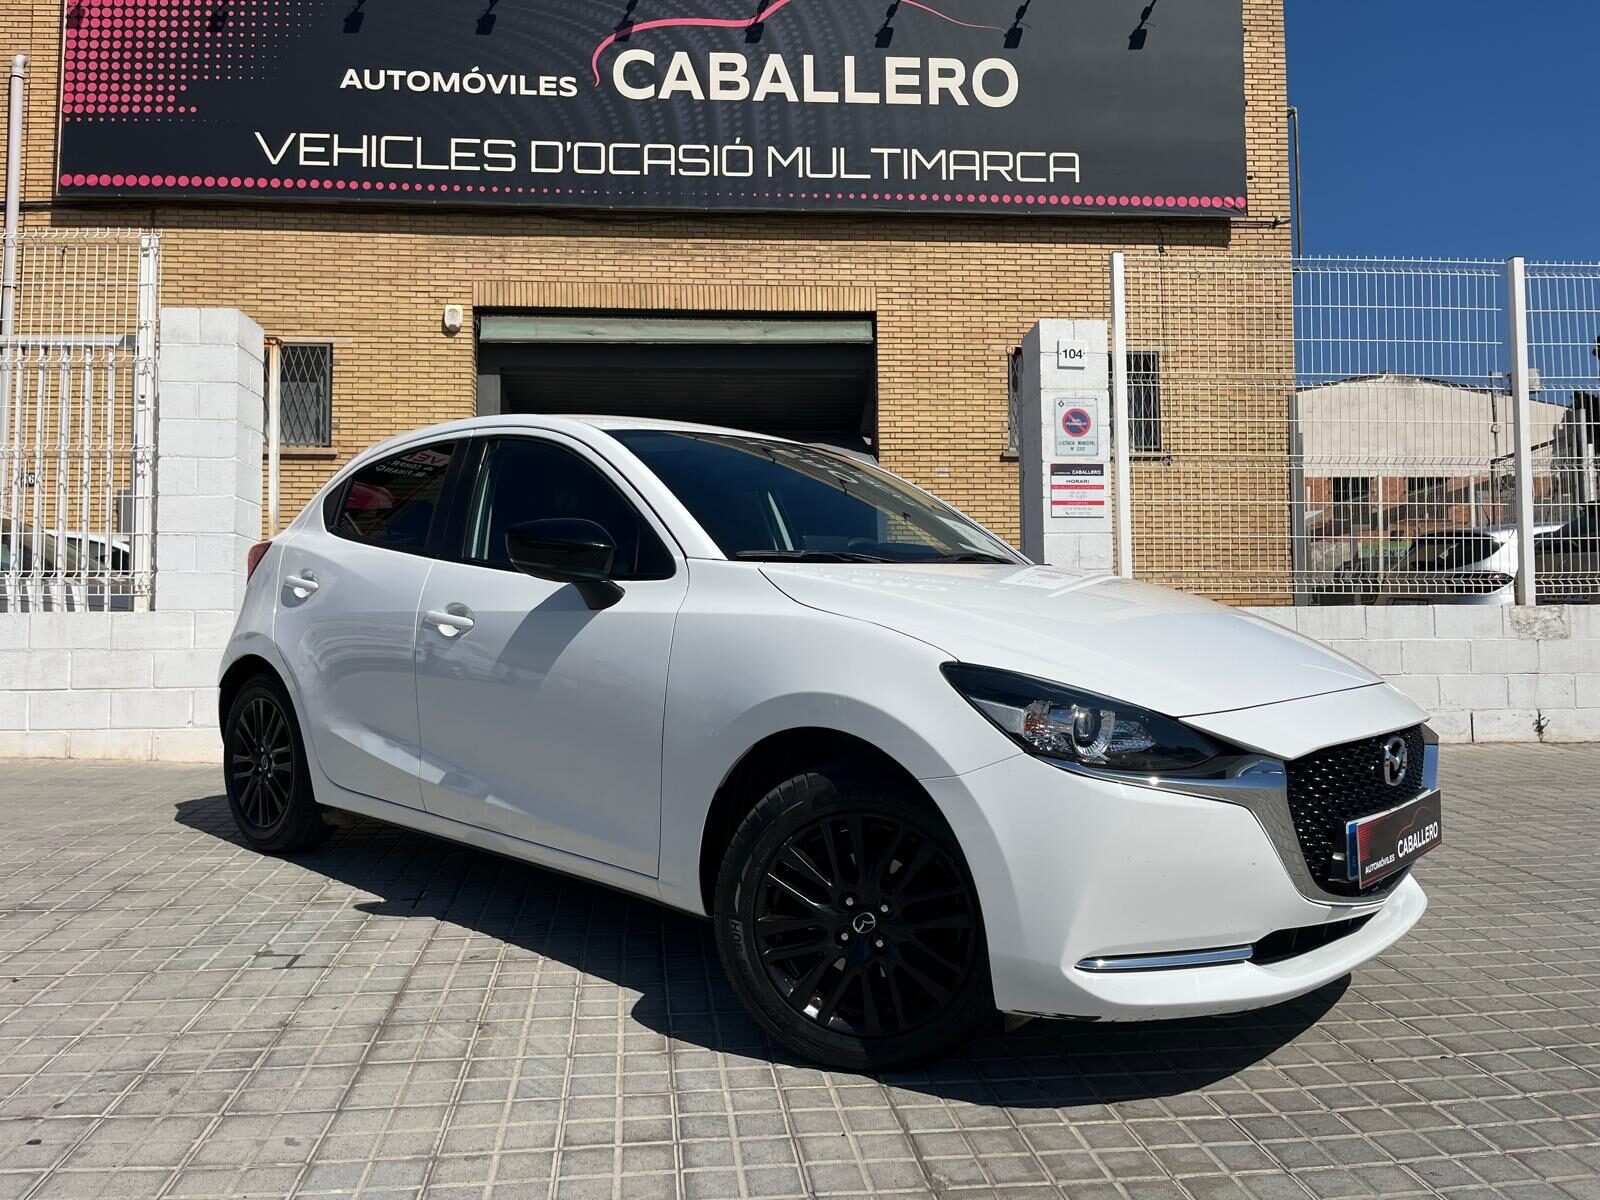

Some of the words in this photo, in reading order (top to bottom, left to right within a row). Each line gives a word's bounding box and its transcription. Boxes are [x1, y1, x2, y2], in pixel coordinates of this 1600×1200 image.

[340, 66, 578, 98] AUTOMÓVILES
[612, 48, 1019, 108] CABALLERO
[254, 131, 517, 174] VEHICLES
[530, 137, 755, 180] D'OCASIÓ
[767, 145, 1081, 185] MULTIMARCA
[1062, 349, 1083, 359] 104
[1365, 853, 1396, 875] AUTOMÓVILES
[1397, 821, 1439, 858] CABALLERO
